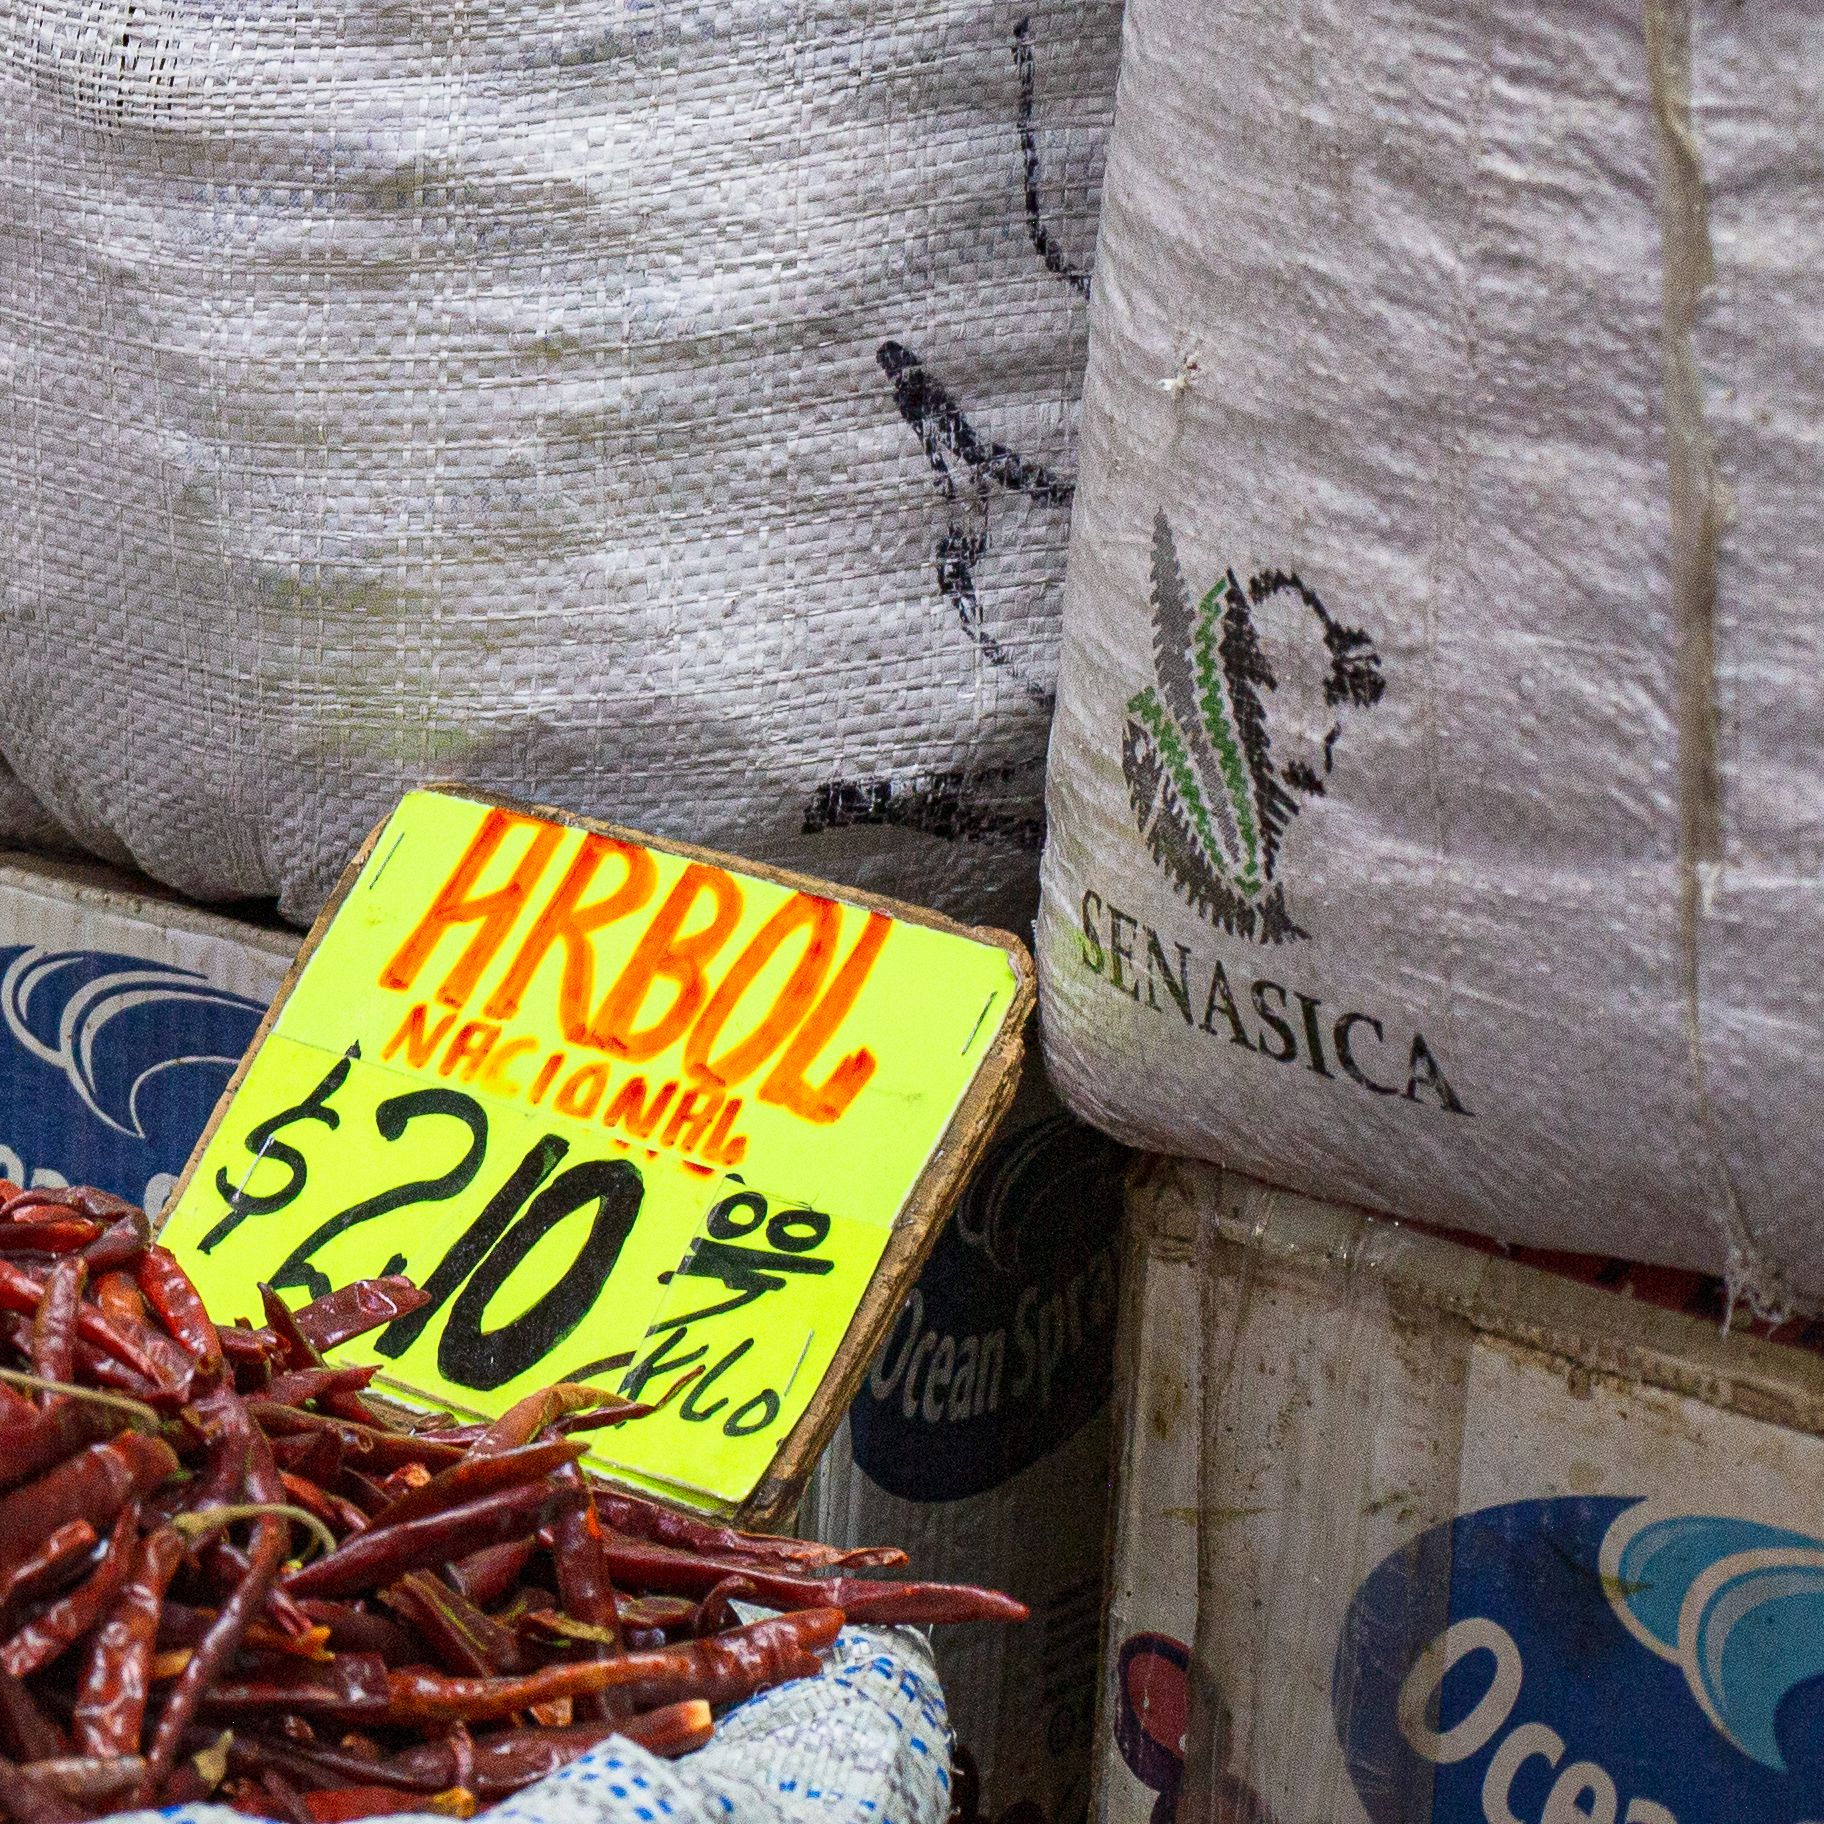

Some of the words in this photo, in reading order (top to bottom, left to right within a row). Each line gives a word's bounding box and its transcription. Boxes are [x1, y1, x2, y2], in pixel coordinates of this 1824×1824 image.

[381, 1003, 748, 1166] NACIONAL
[1081, 888, 1474, 1117] SENASICA
[197, 1039, 644, 1392] $210
[870, 1288, 1006, 1423] Ocean
